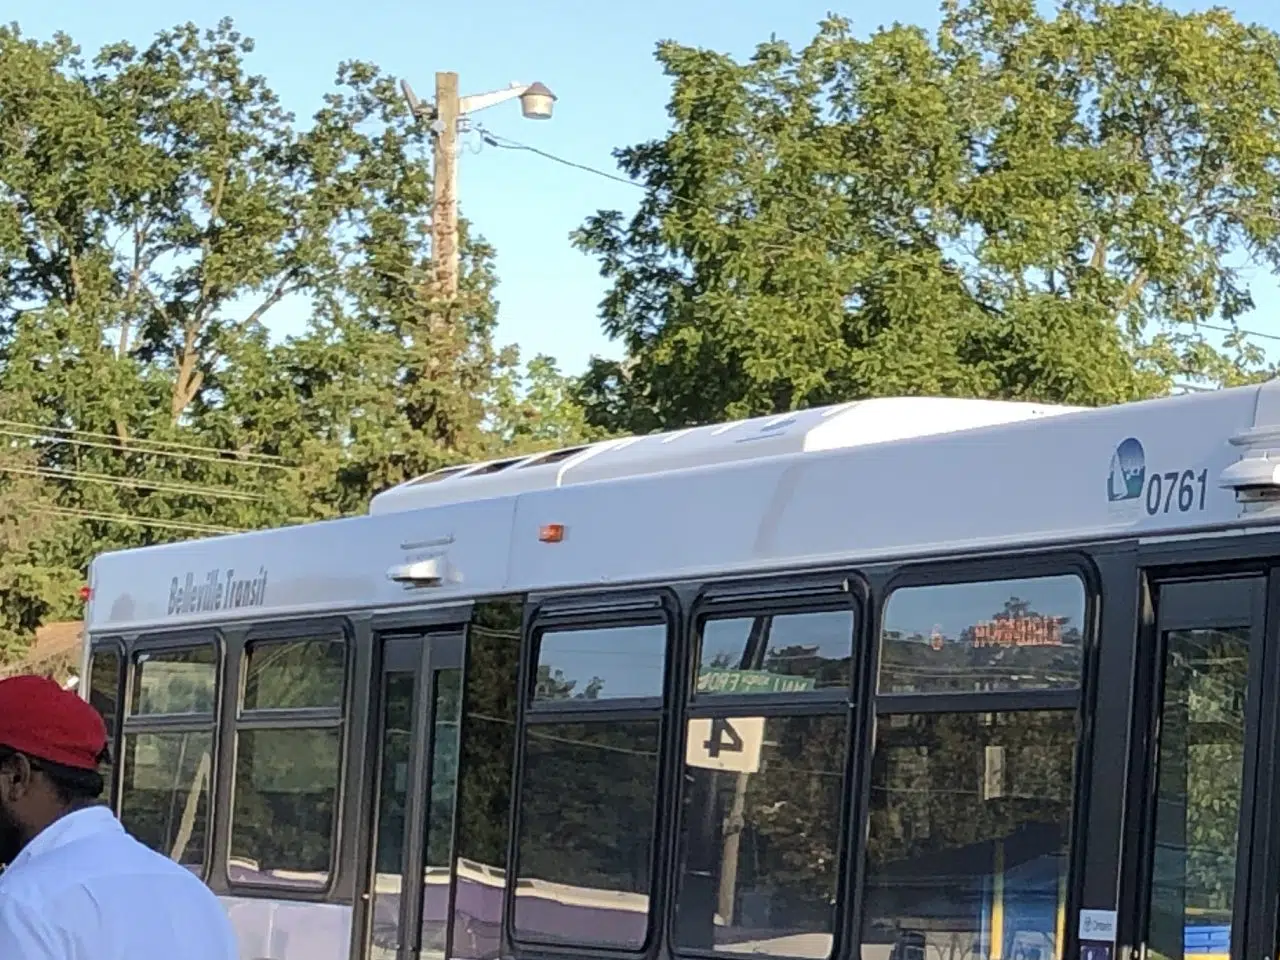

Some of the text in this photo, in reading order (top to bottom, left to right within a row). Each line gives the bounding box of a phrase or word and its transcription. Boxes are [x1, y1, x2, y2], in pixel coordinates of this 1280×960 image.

[1146, 467, 1208, 516] 0761
[167, 564, 269, 615] Belleville Transit
